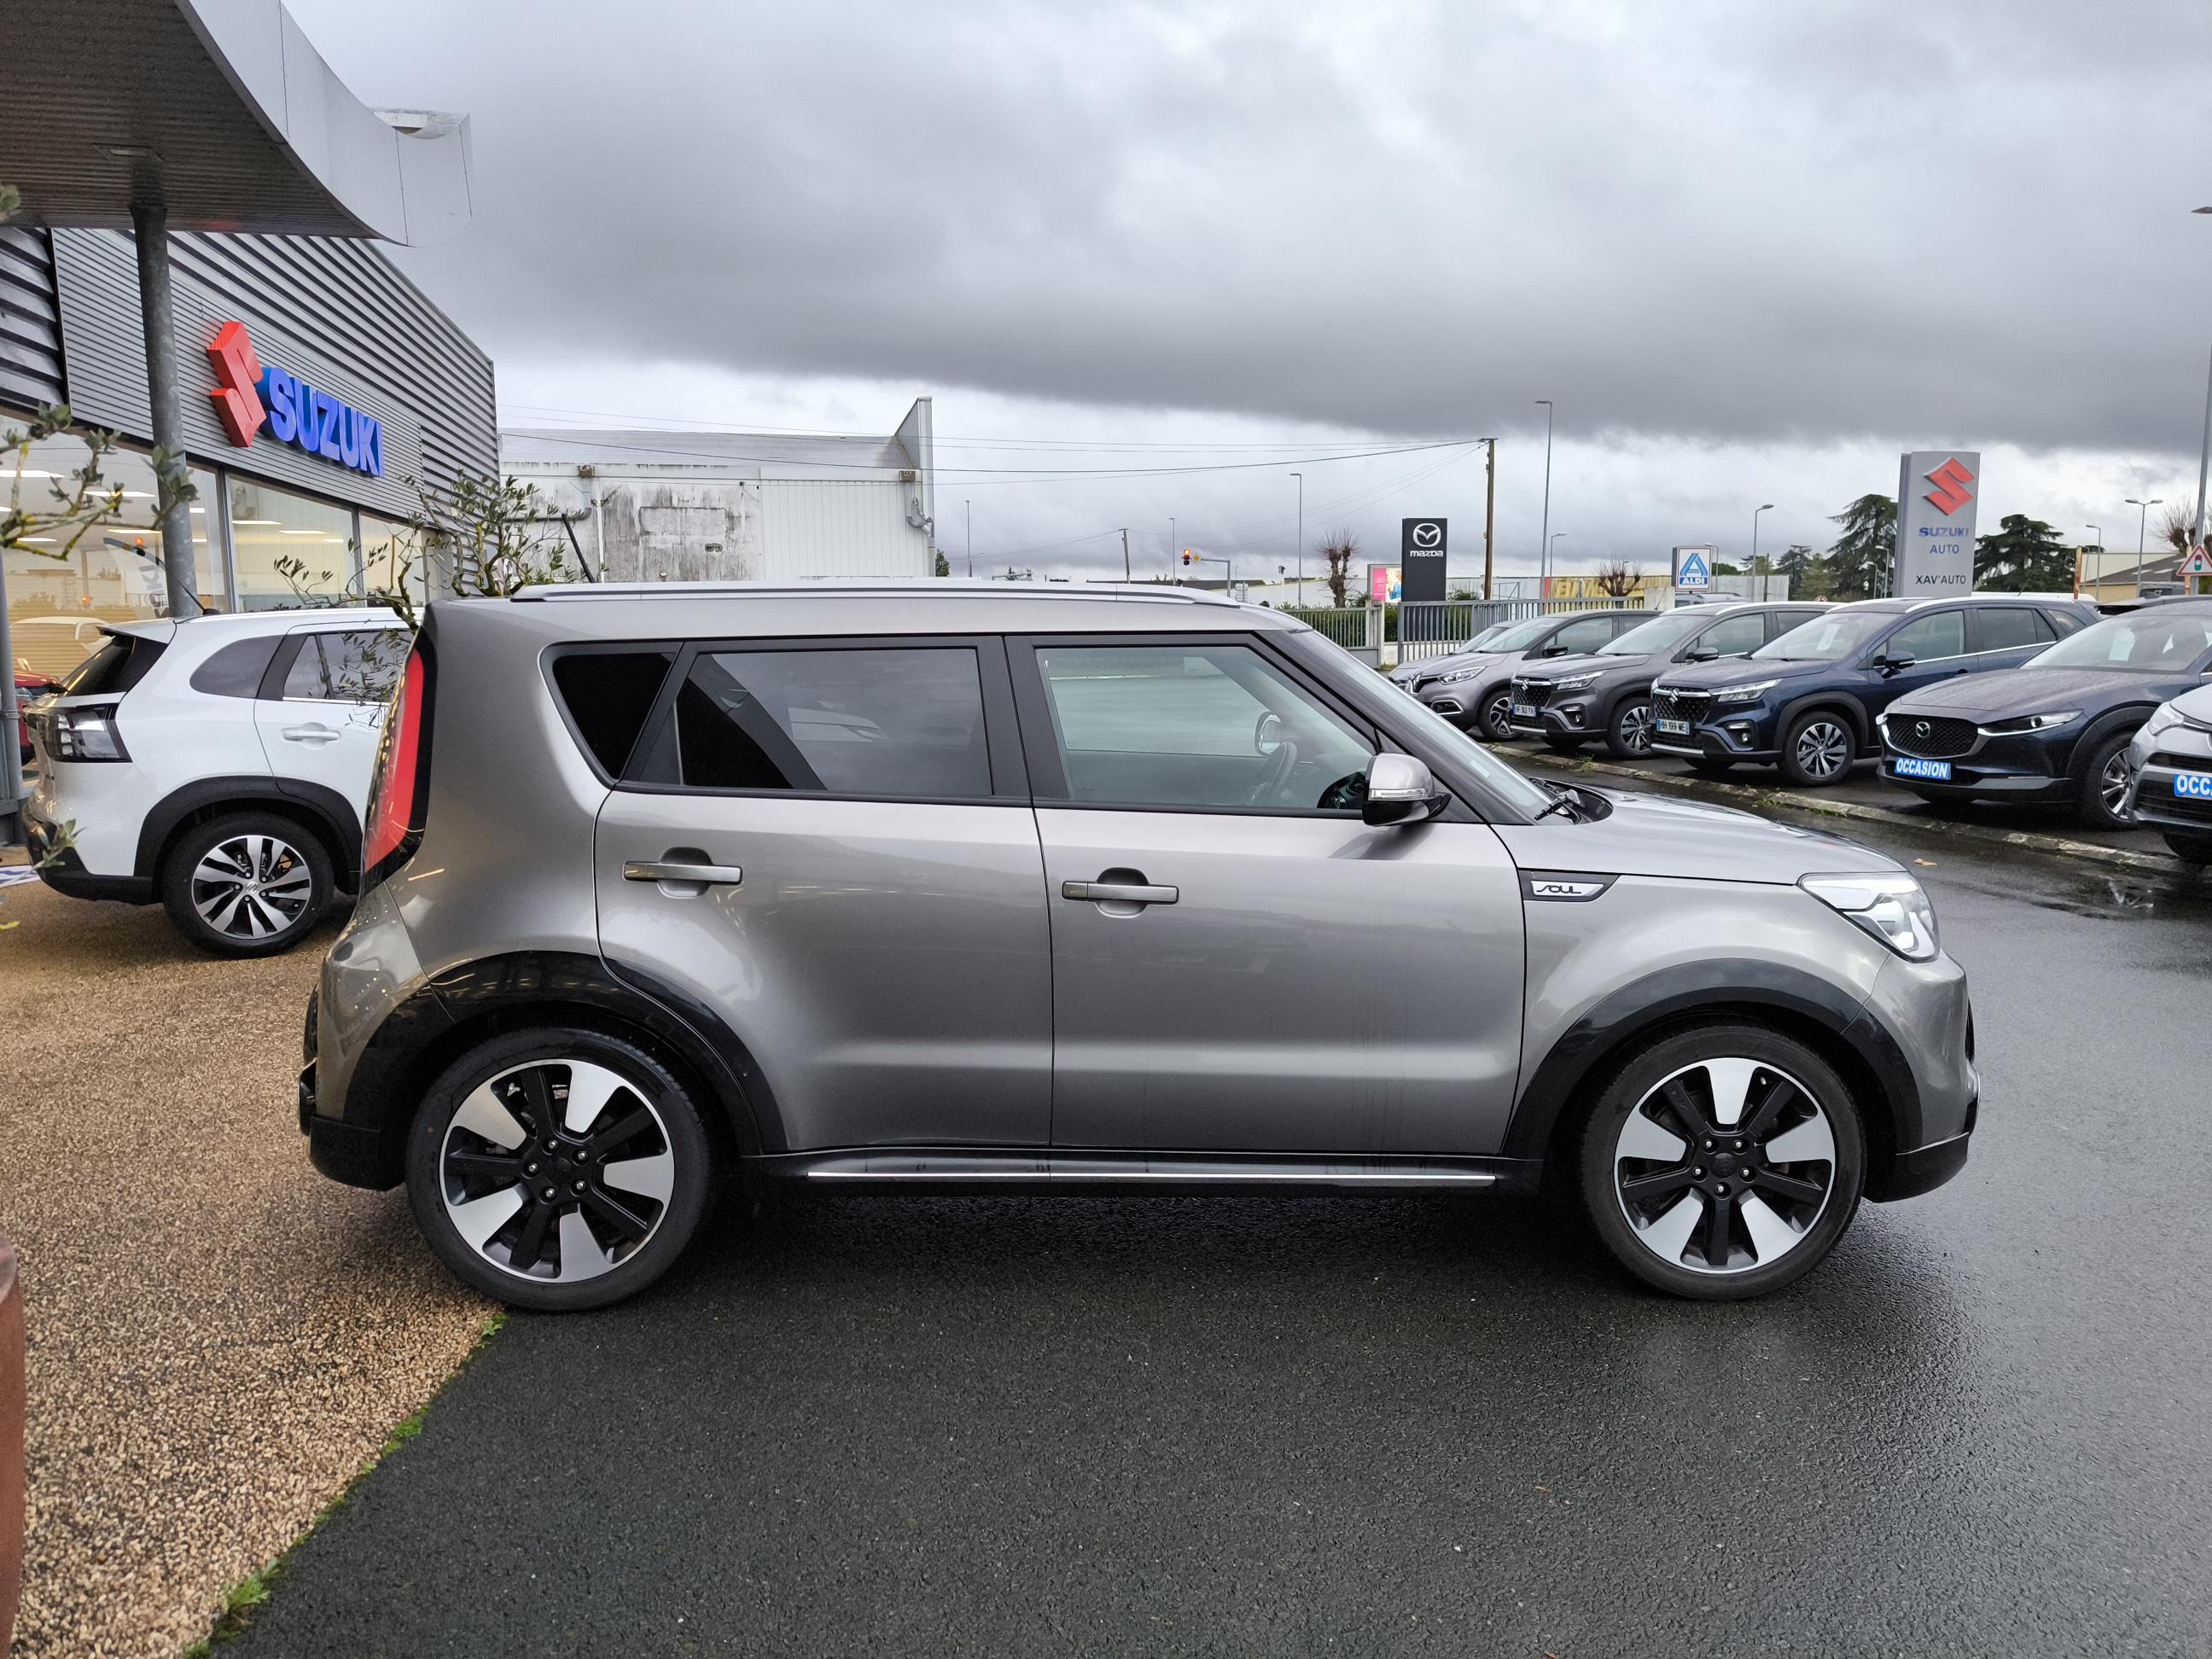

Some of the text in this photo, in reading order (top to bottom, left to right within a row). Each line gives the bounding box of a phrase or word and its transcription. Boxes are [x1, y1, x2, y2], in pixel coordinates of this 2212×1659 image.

[264, 367, 386, 479] SUZUKI
[1918, 527, 1969, 537] SUZUKI
[1930, 544, 1959, 554] AUTO
[1915, 574, 1966, 585] XAV'AUTO
[1896, 759, 1948, 777] OCCASION
[1536, 885, 1581, 894] SOUL
